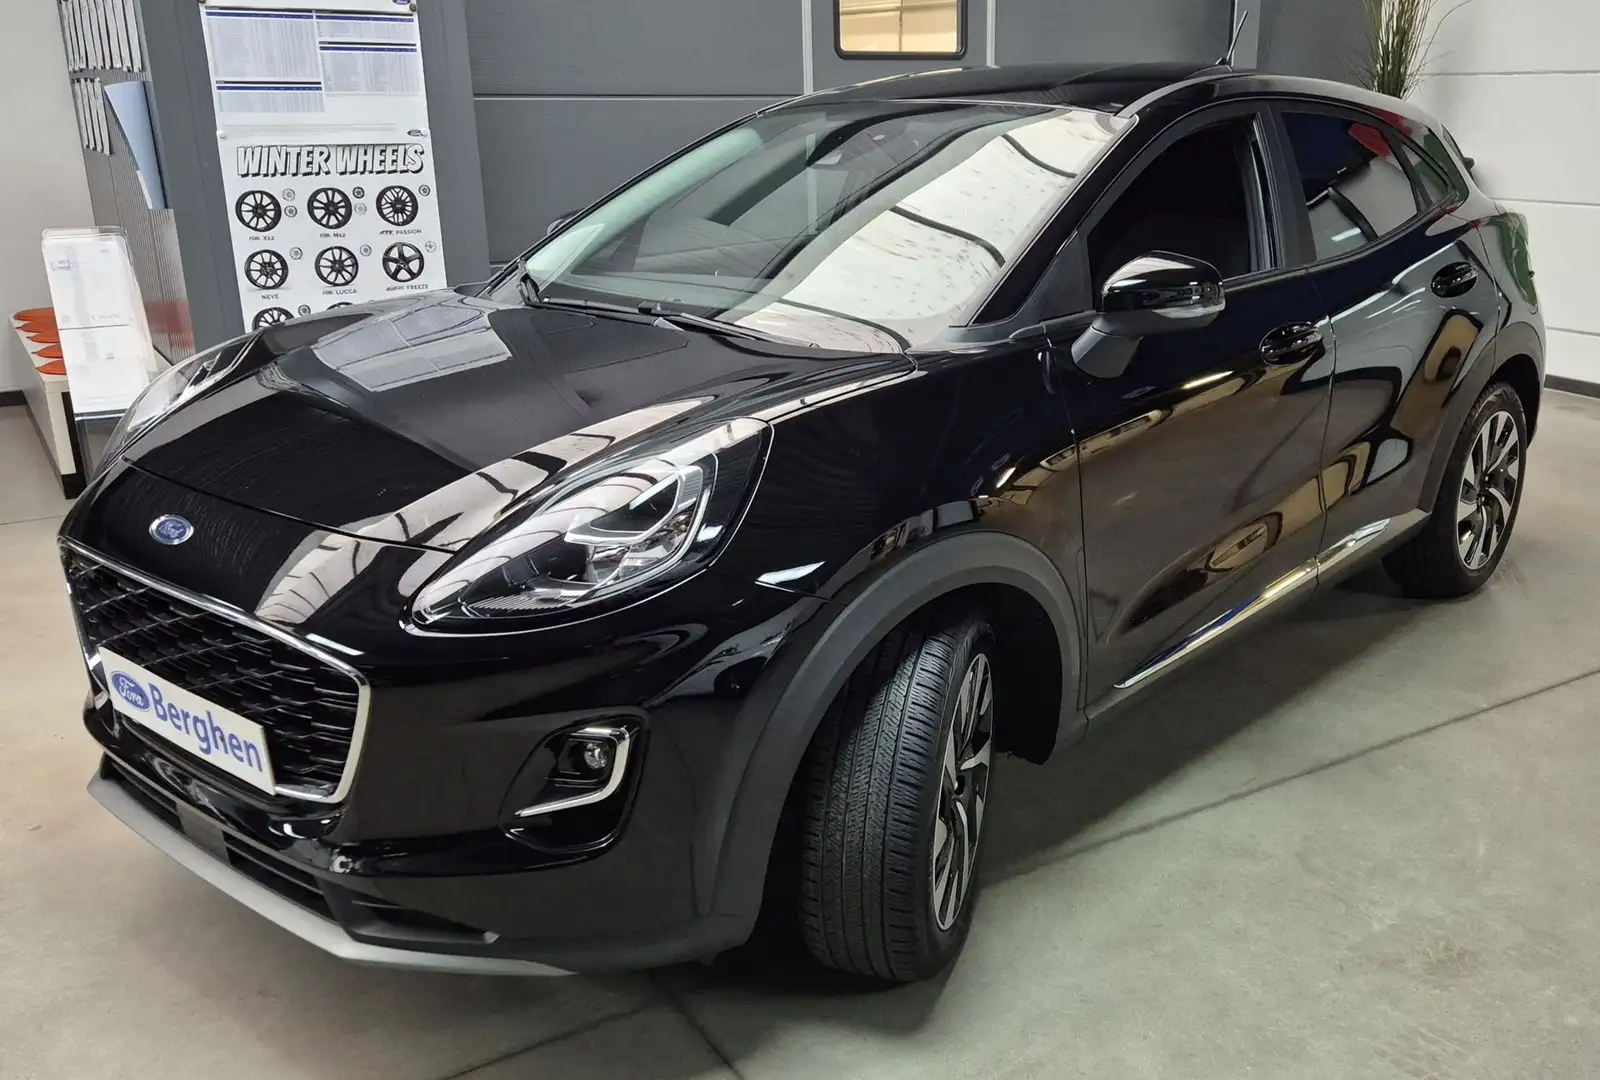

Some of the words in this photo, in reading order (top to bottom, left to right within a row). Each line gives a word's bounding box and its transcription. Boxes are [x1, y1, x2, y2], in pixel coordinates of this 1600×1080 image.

[236, 143, 332, 178] WINTER
[335, 143, 426, 174] WHEELS
[335, 288, 358, 296] LUCCA
[147, 681, 263, 773] Berghen
